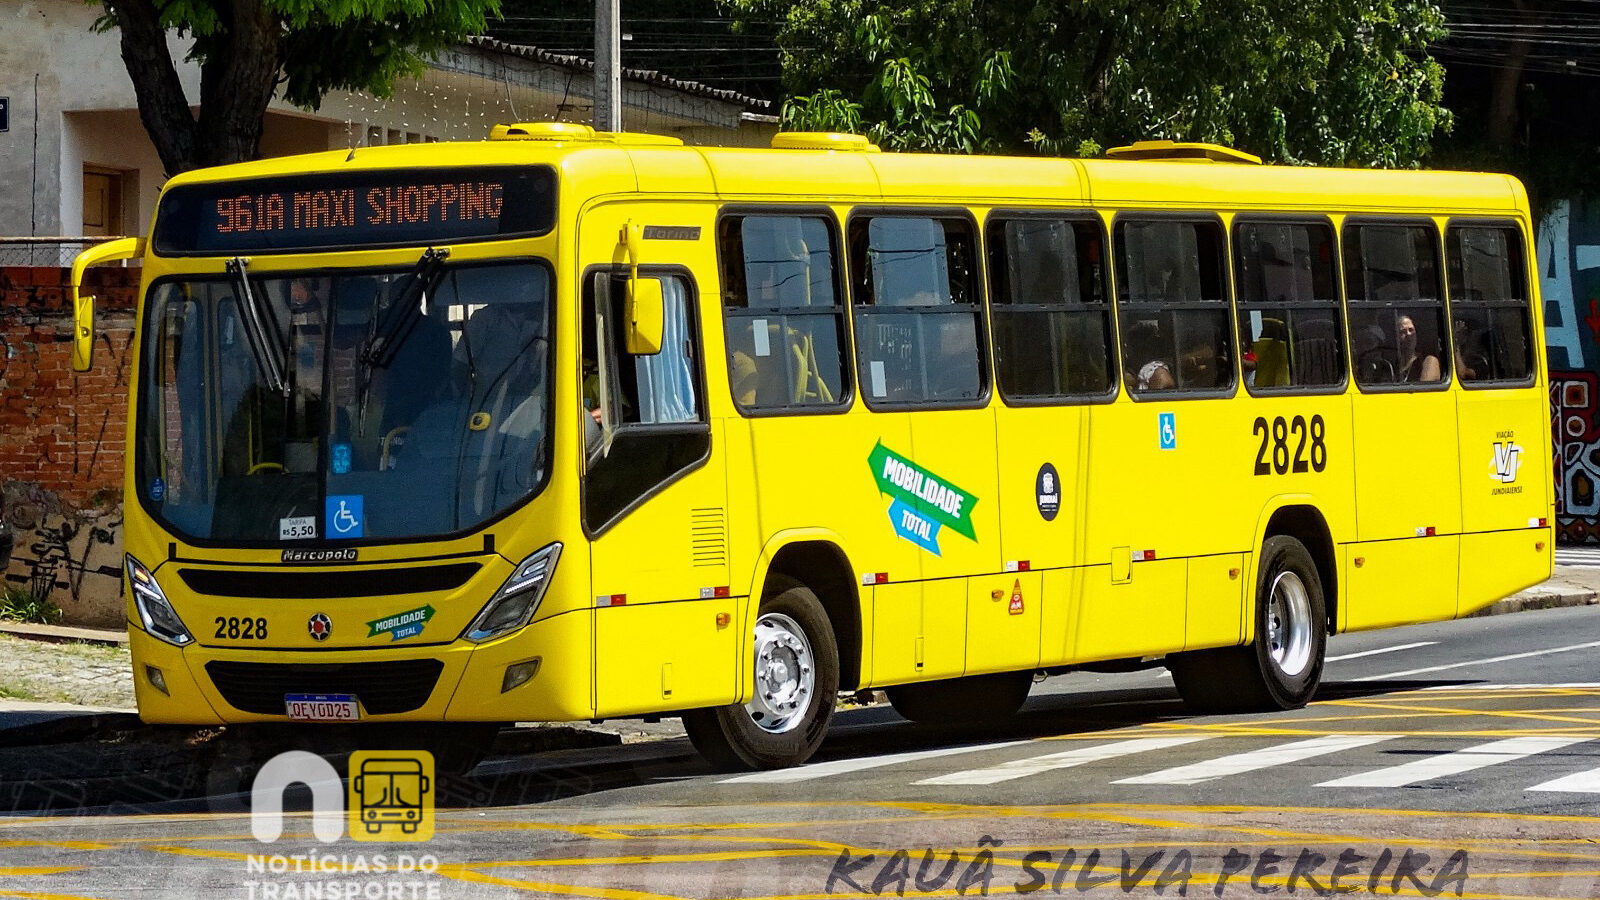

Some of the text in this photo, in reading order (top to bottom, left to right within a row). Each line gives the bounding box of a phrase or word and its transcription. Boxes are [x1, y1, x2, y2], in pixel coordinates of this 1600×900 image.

[216, 182, 503, 233] 961A MAXI SHOPPING
[1253, 414, 1327, 476] 2828
[882, 455, 964, 519] MOBILIDADE
[290, 525, 314, 537] 5,50
[901, 509, 932, 542] TOTAL
[283, 549, 356, 561] Marcopolo
[214, 616, 268, 640] 2828
[375, 609, 426, 632] MOBILIDADE
[396, 626, 417, 637] TOTAL
